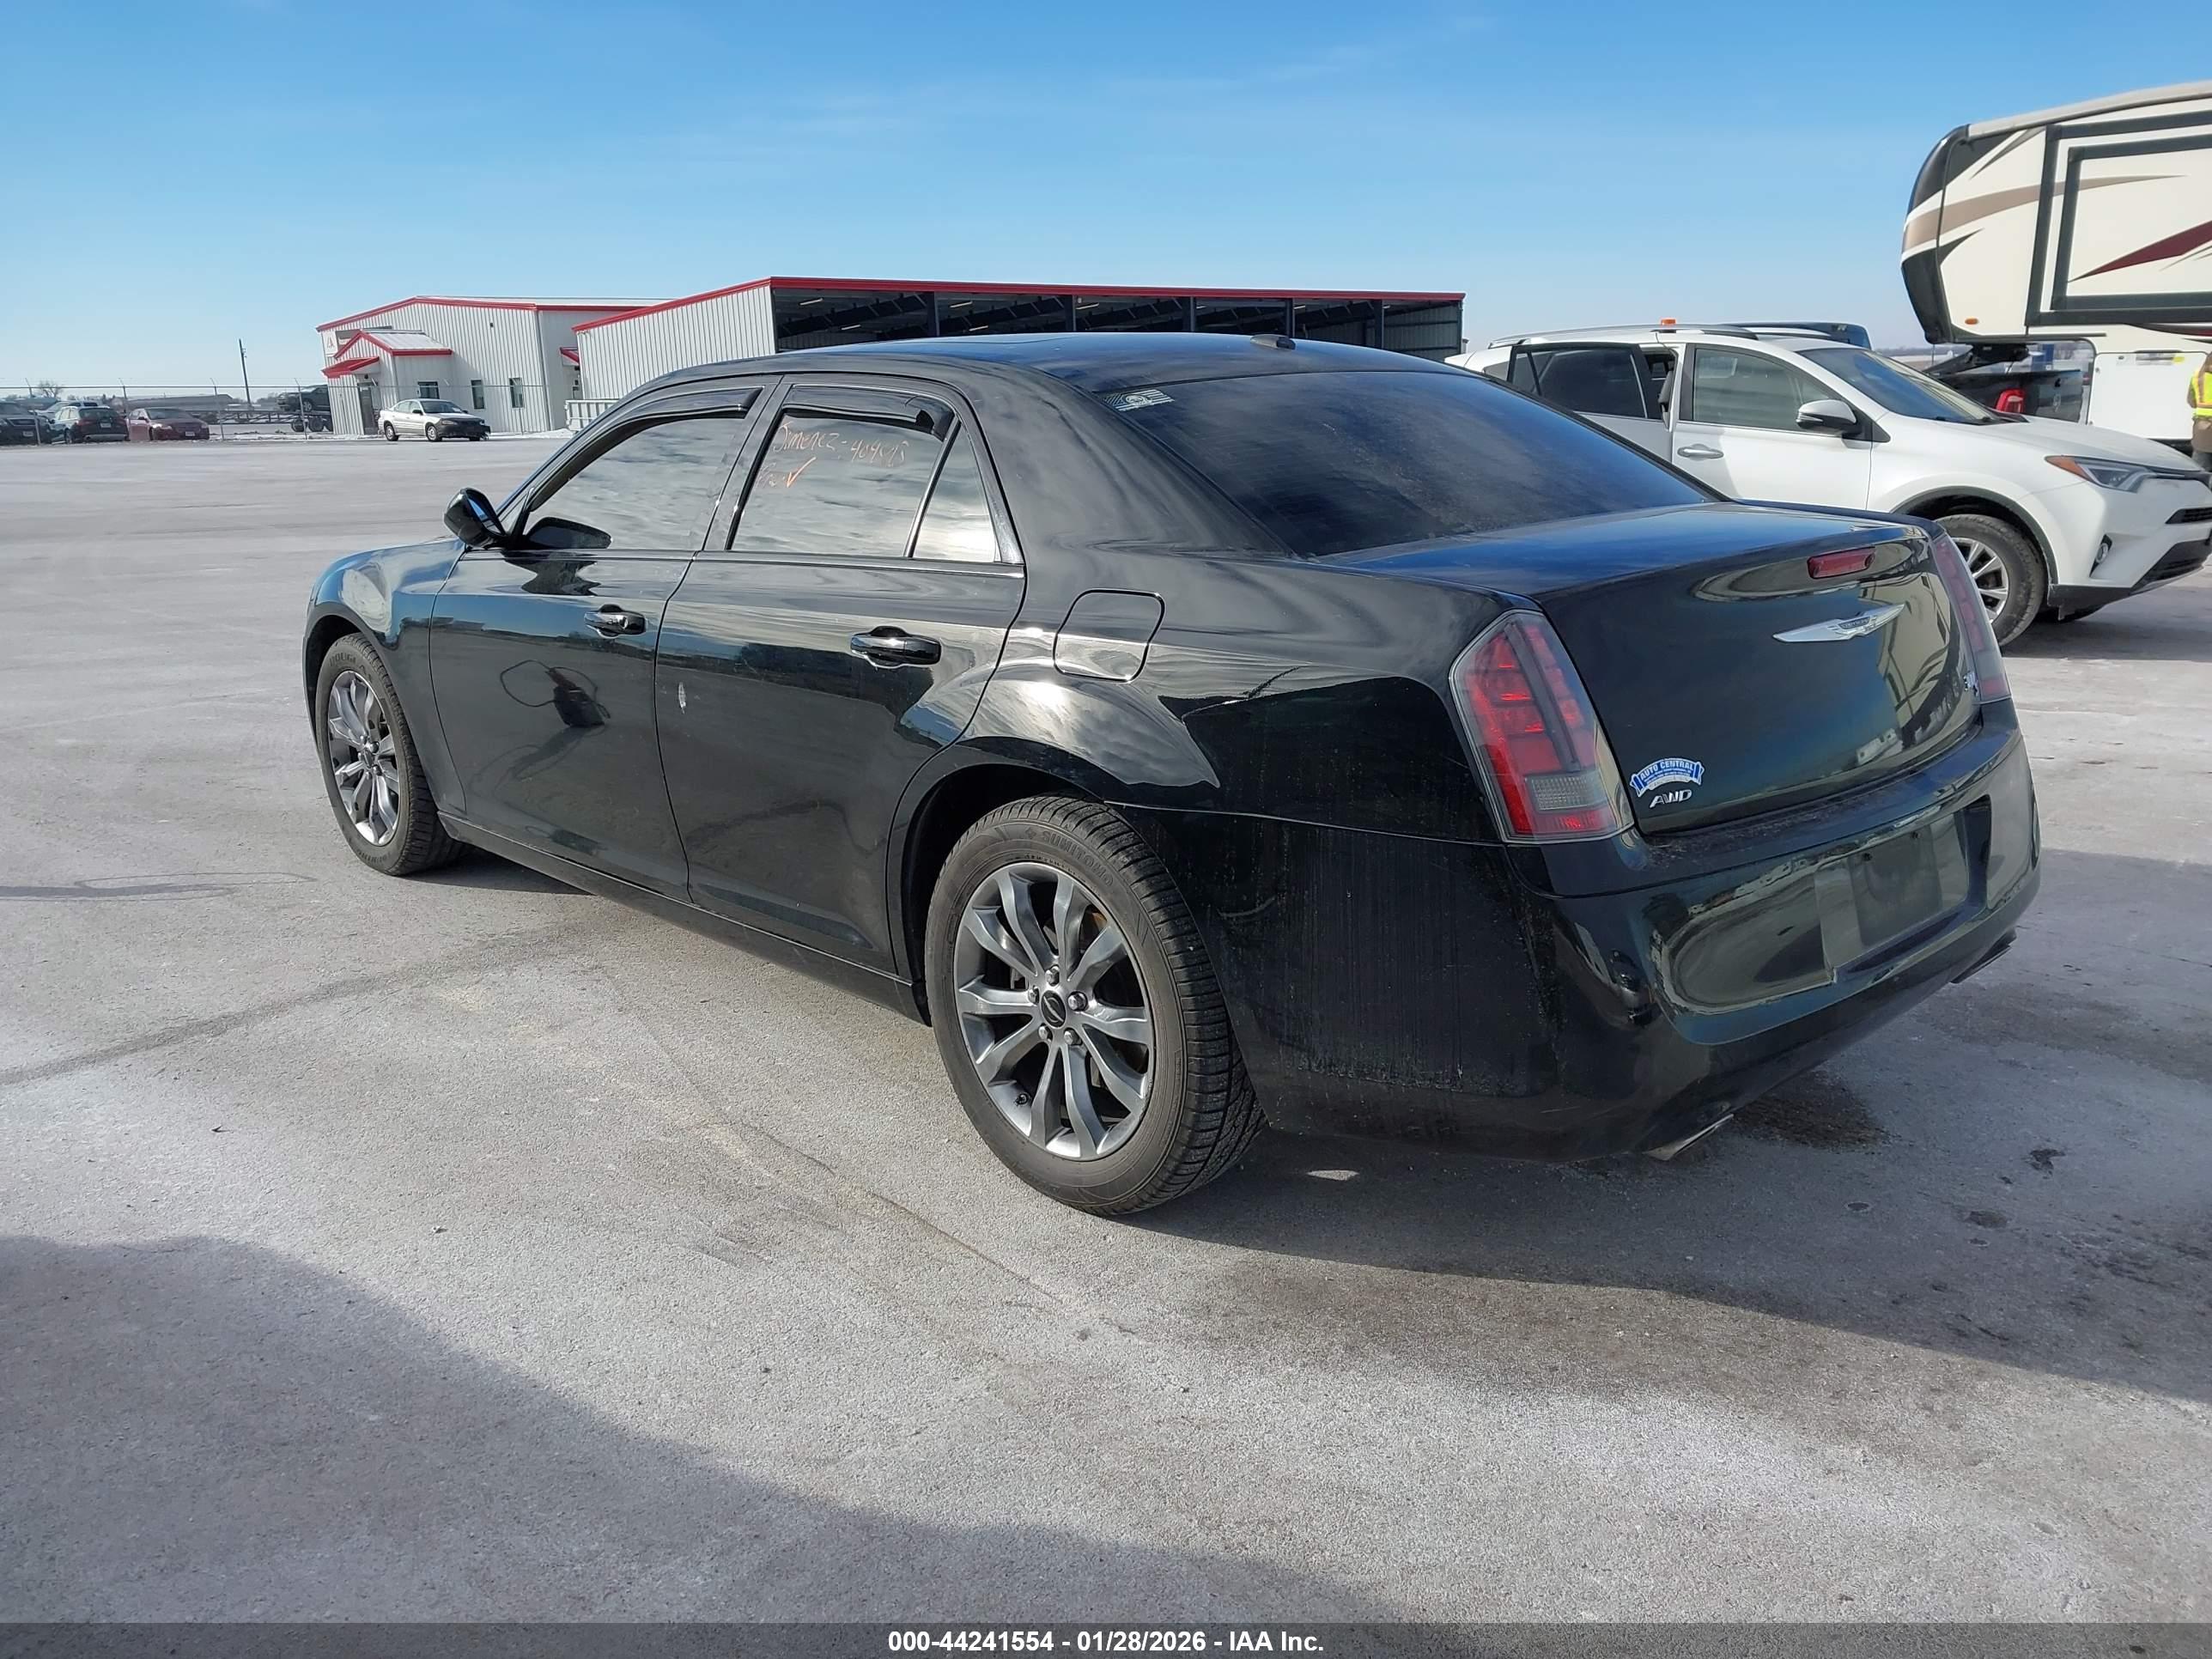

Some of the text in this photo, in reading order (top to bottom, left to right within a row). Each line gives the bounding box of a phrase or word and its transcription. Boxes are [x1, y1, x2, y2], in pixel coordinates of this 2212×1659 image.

[1640, 764, 1659, 781] AUTO
[1661, 761, 1695, 771] CENTRAL
[1649, 789, 1692, 808] AWD
